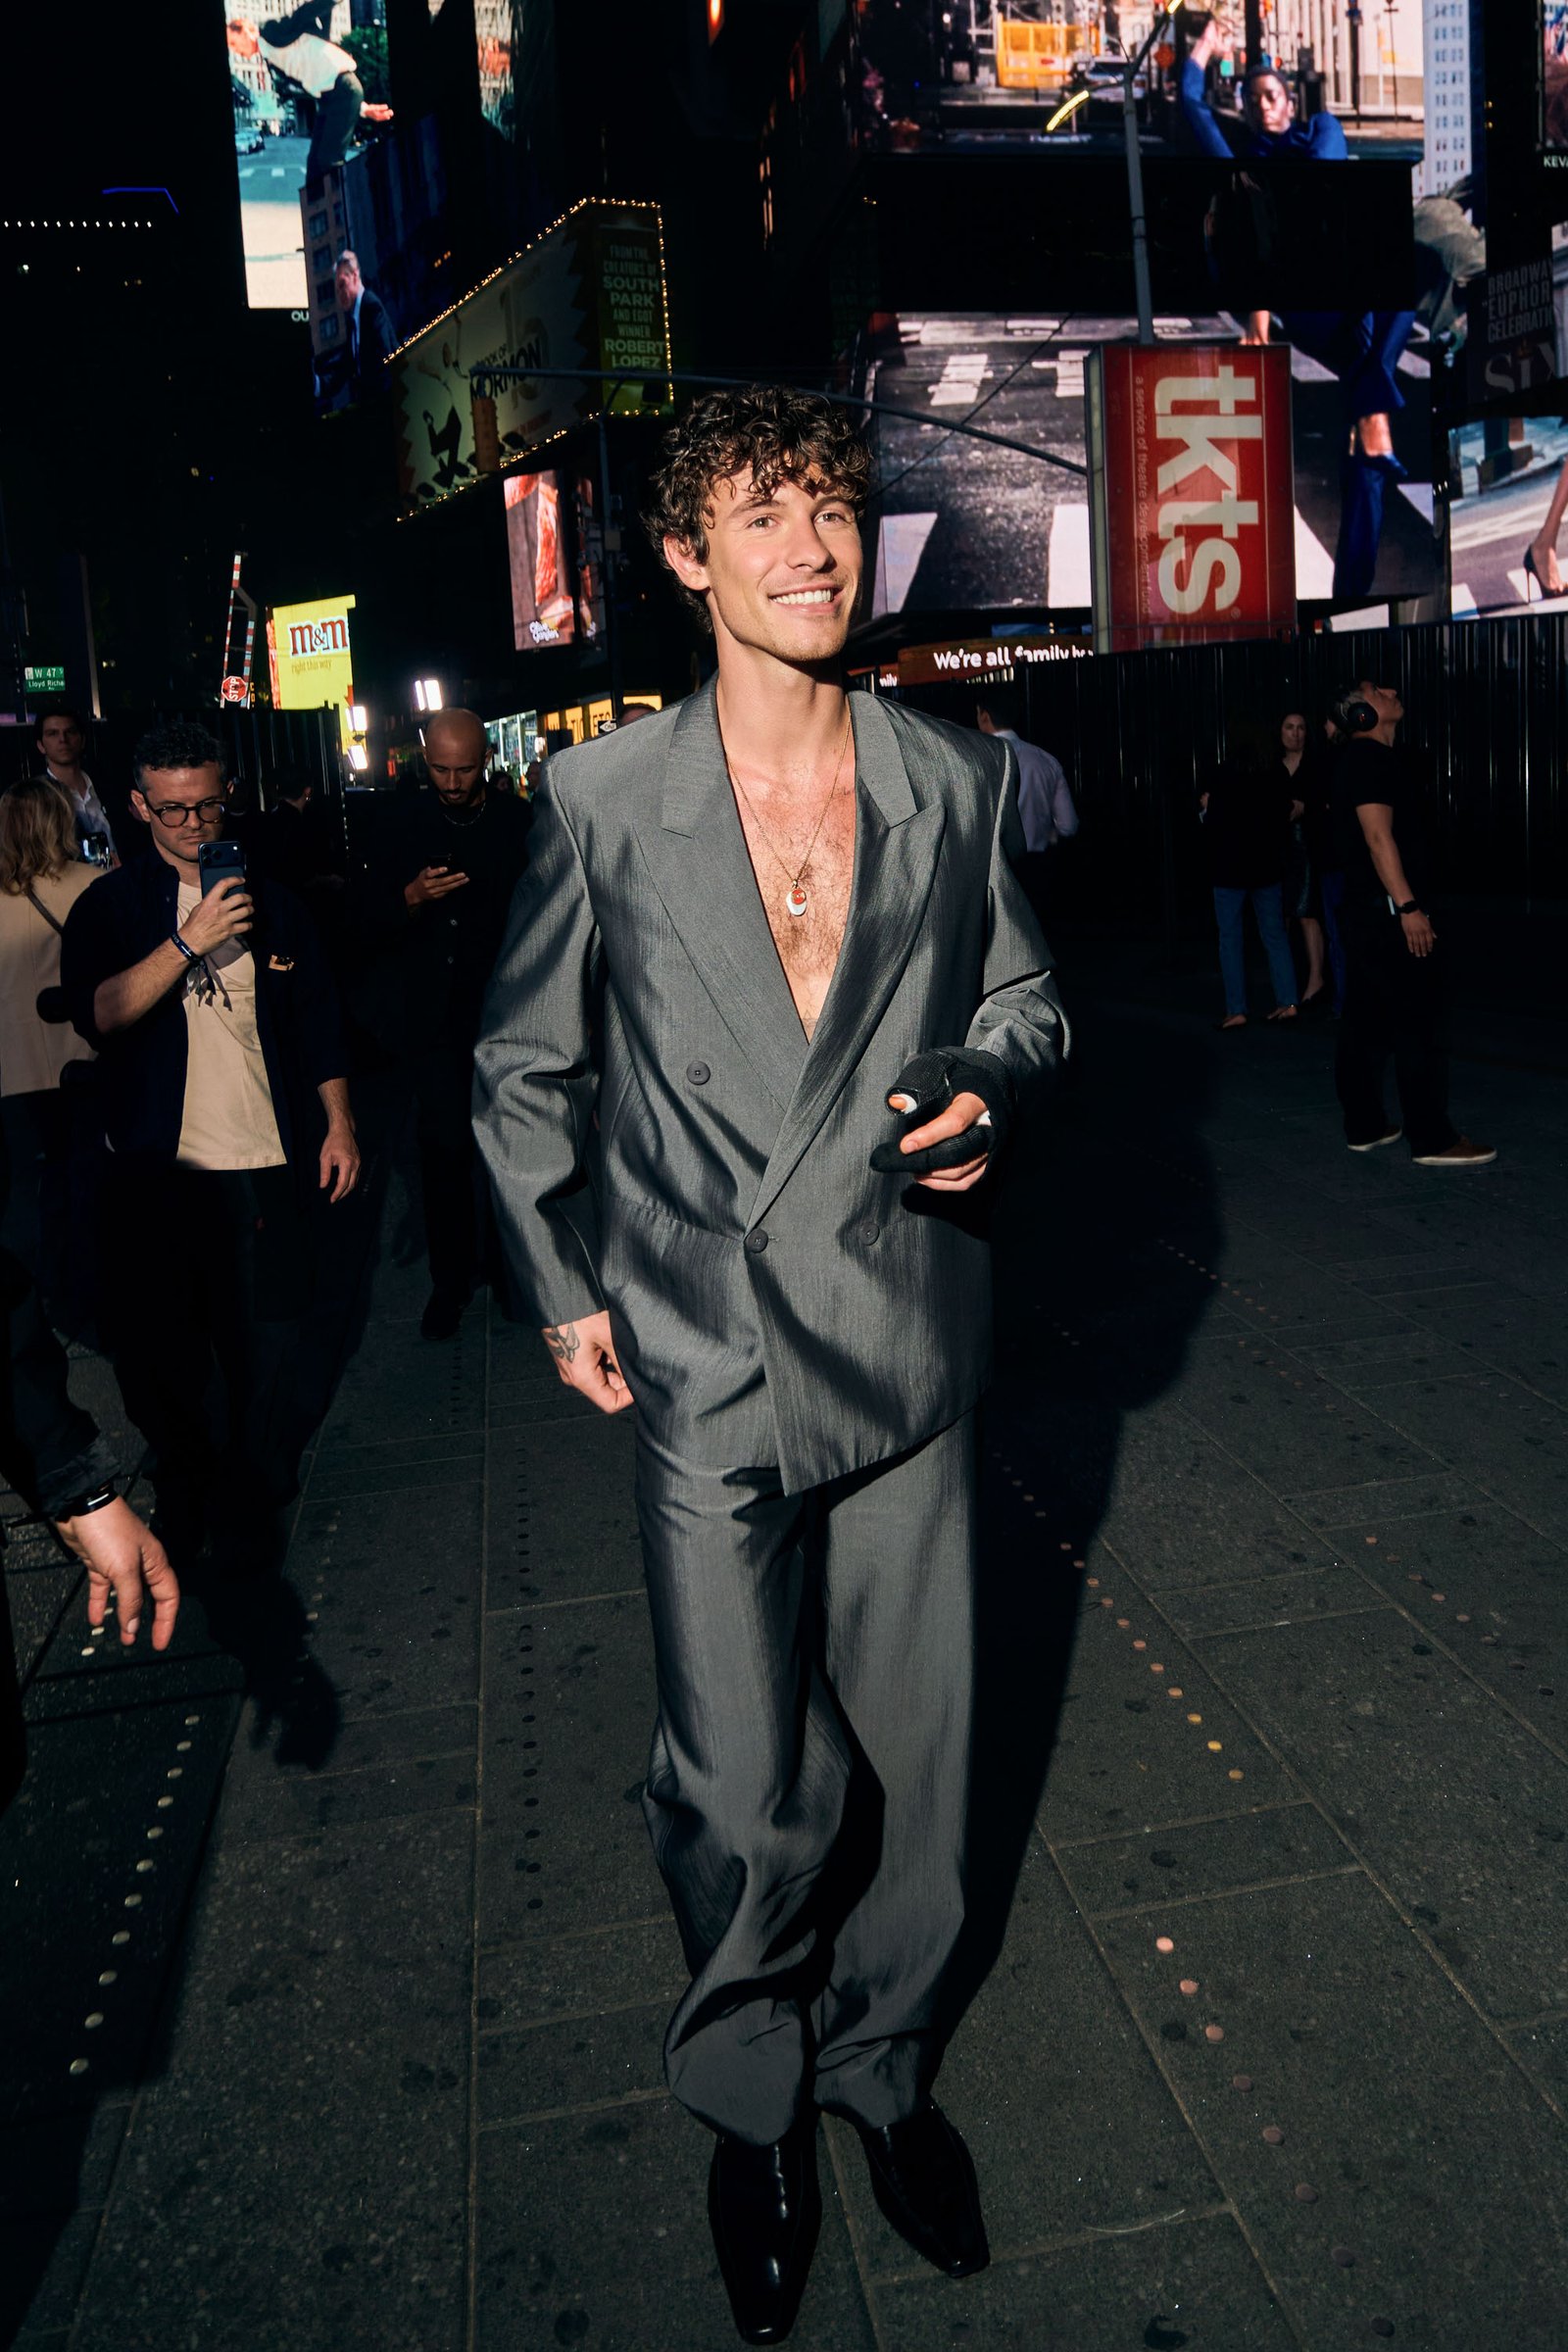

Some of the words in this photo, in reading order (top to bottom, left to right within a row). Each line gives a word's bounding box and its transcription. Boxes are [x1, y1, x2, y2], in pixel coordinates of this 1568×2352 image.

[603, 275, 661, 292] SOUTH
[610, 292, 656, 309] PARK
[612, 309, 631, 322] AND
[616, 324, 652, 338] WINNER
[604, 338, 664, 355] ROBERT
[611, 355, 662, 370] LOPEZ
[1136, 389, 1147, 433] service
[1137, 437, 1148, 450] of
[1138, 454, 1148, 498] theatre
[1153, 365, 1262, 614] tkts
[1138, 502, 1151, 582] development
[1141, 586, 1152, 614] fund
[933, 648, 982, 670] We're
[986, 646, 1011, 665] all
[34, 668, 43, 678] W
[46, 667, 57, 678] 47
[291, 662, 307, 674] right
[307, 662, 319, 670] this
[318, 660, 332, 672] way
[28, 680, 46, 689] Lloyd
[228, 677, 240, 701] STOP
